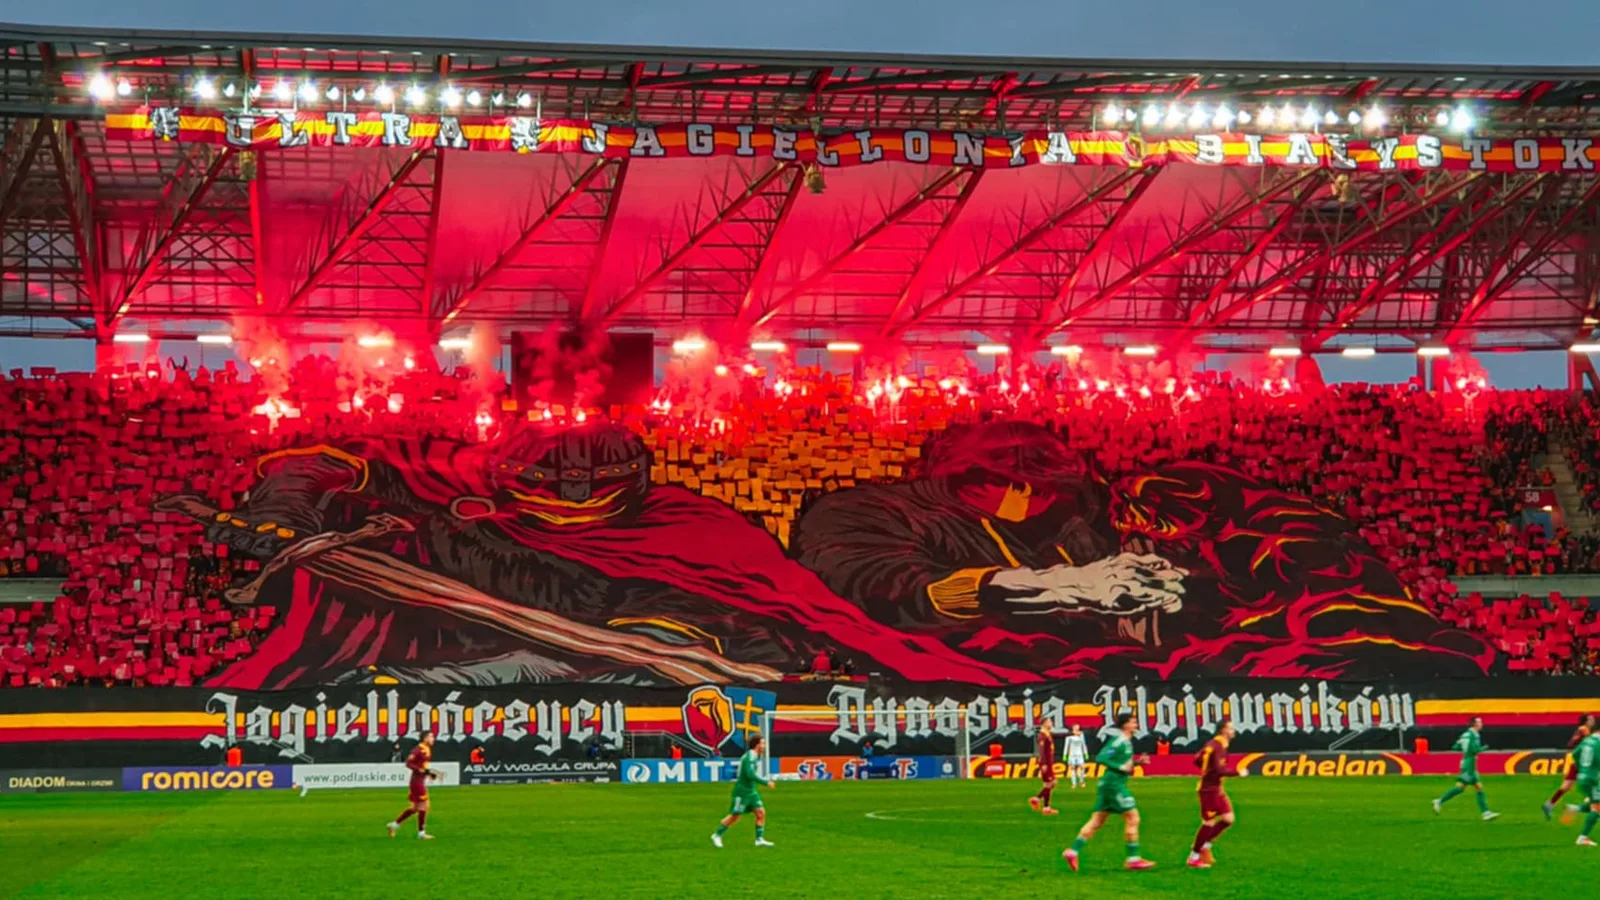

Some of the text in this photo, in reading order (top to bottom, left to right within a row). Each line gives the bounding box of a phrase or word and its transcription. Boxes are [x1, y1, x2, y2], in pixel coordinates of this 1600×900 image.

[223, 110, 470, 148] ULTRA
[581, 122, 1078, 167] JAGIELLONIA
[200, 689, 624, 758] Jagiellończycy
[827, 684, 1069, 749] Dynastia
[573, 761, 617, 771] GRUPA
[1262, 753, 1387, 777] arhelan
[9, 776, 66, 788] DIADOM
[142, 770, 274, 790] romicore
[303, 771, 405, 784] www.podlaskie.eu
